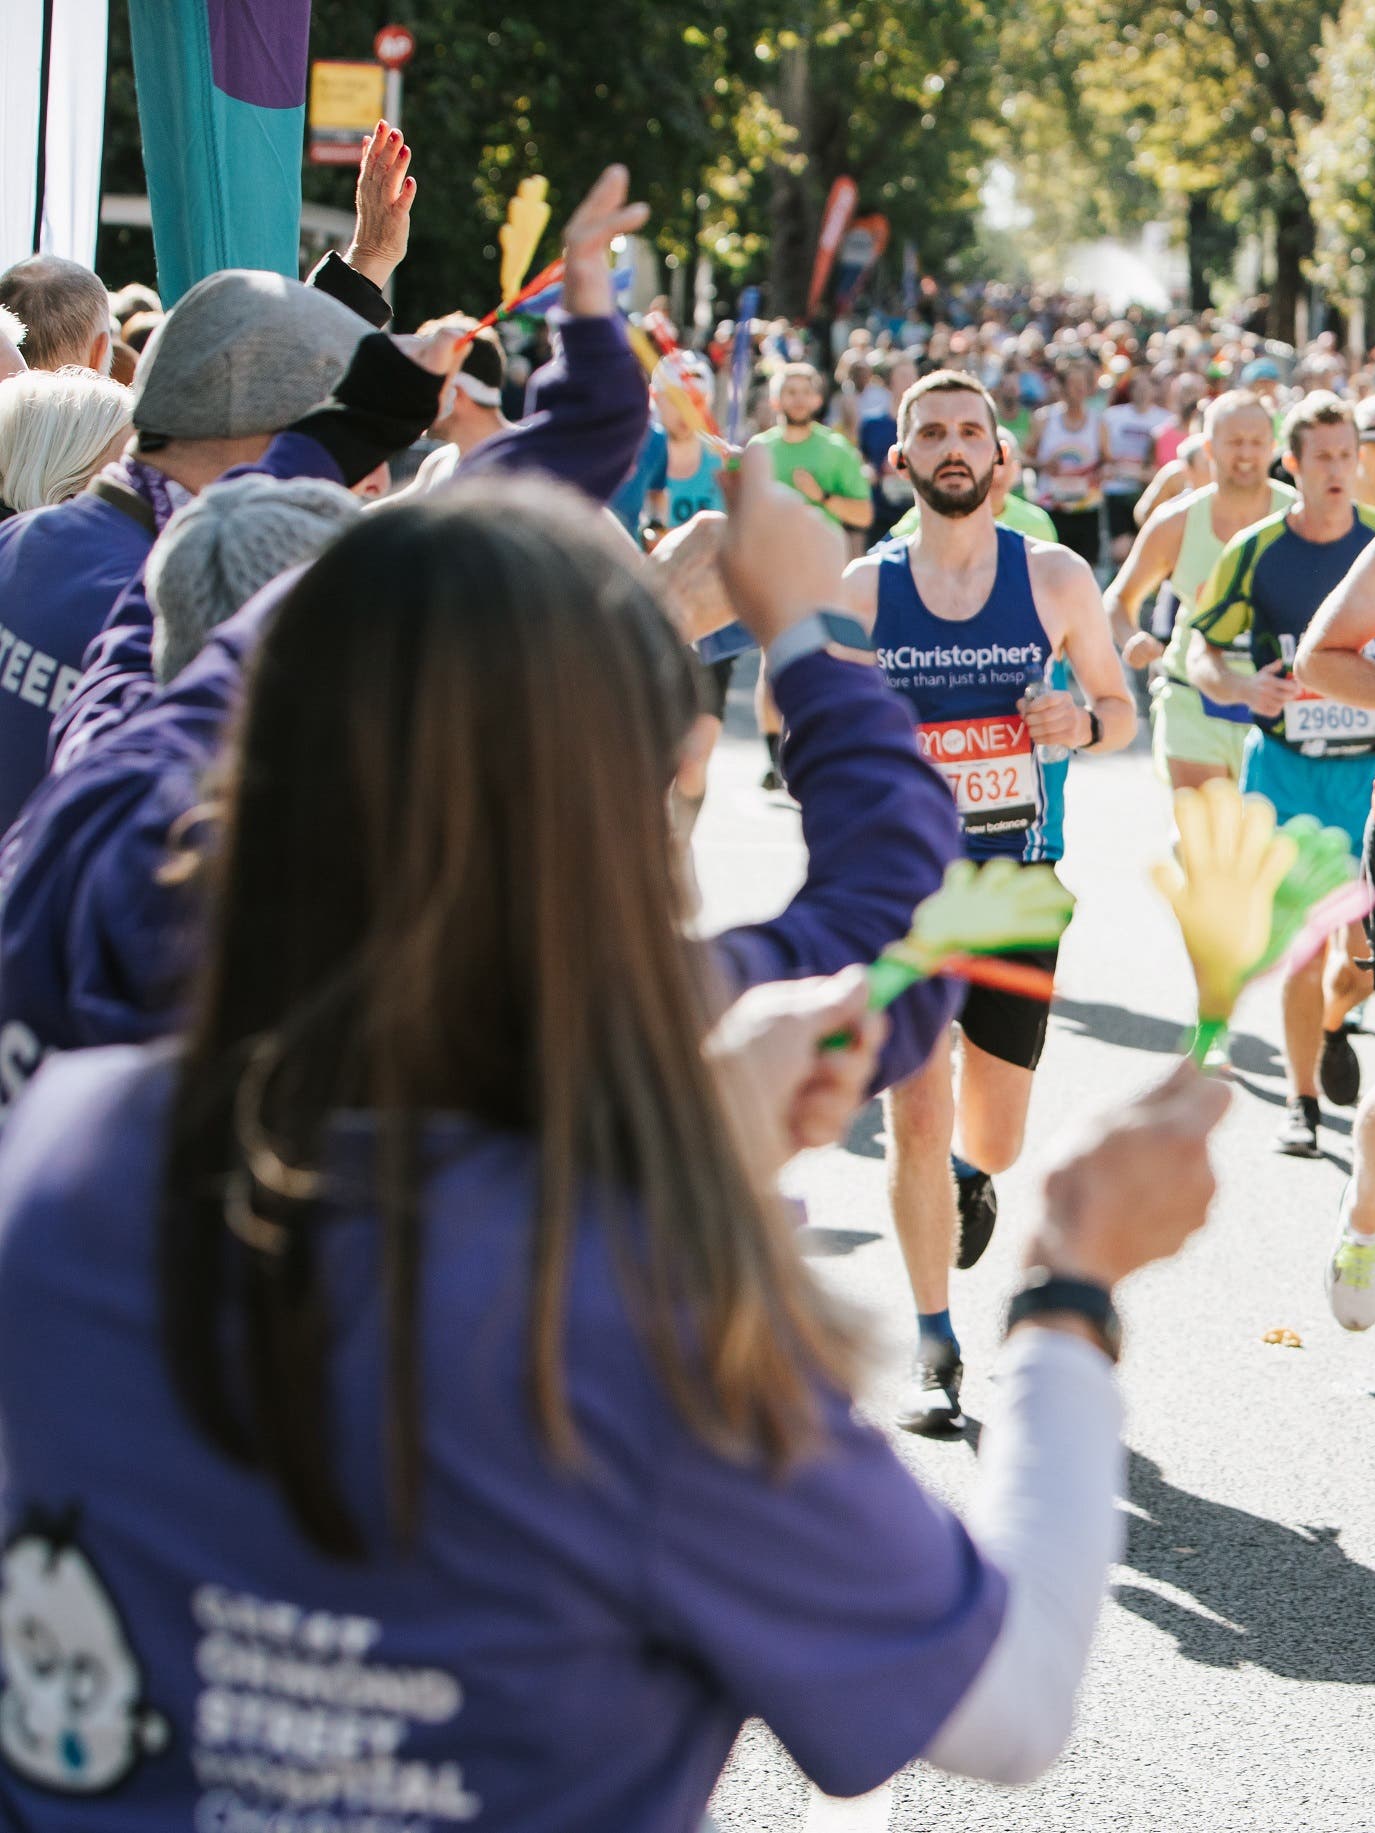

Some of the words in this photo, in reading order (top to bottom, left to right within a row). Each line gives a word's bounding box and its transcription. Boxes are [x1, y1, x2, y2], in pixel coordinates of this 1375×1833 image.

[914, 673, 945, 687] than
[949, 671, 974, 688] just
[979, 676, 987, 684] a
